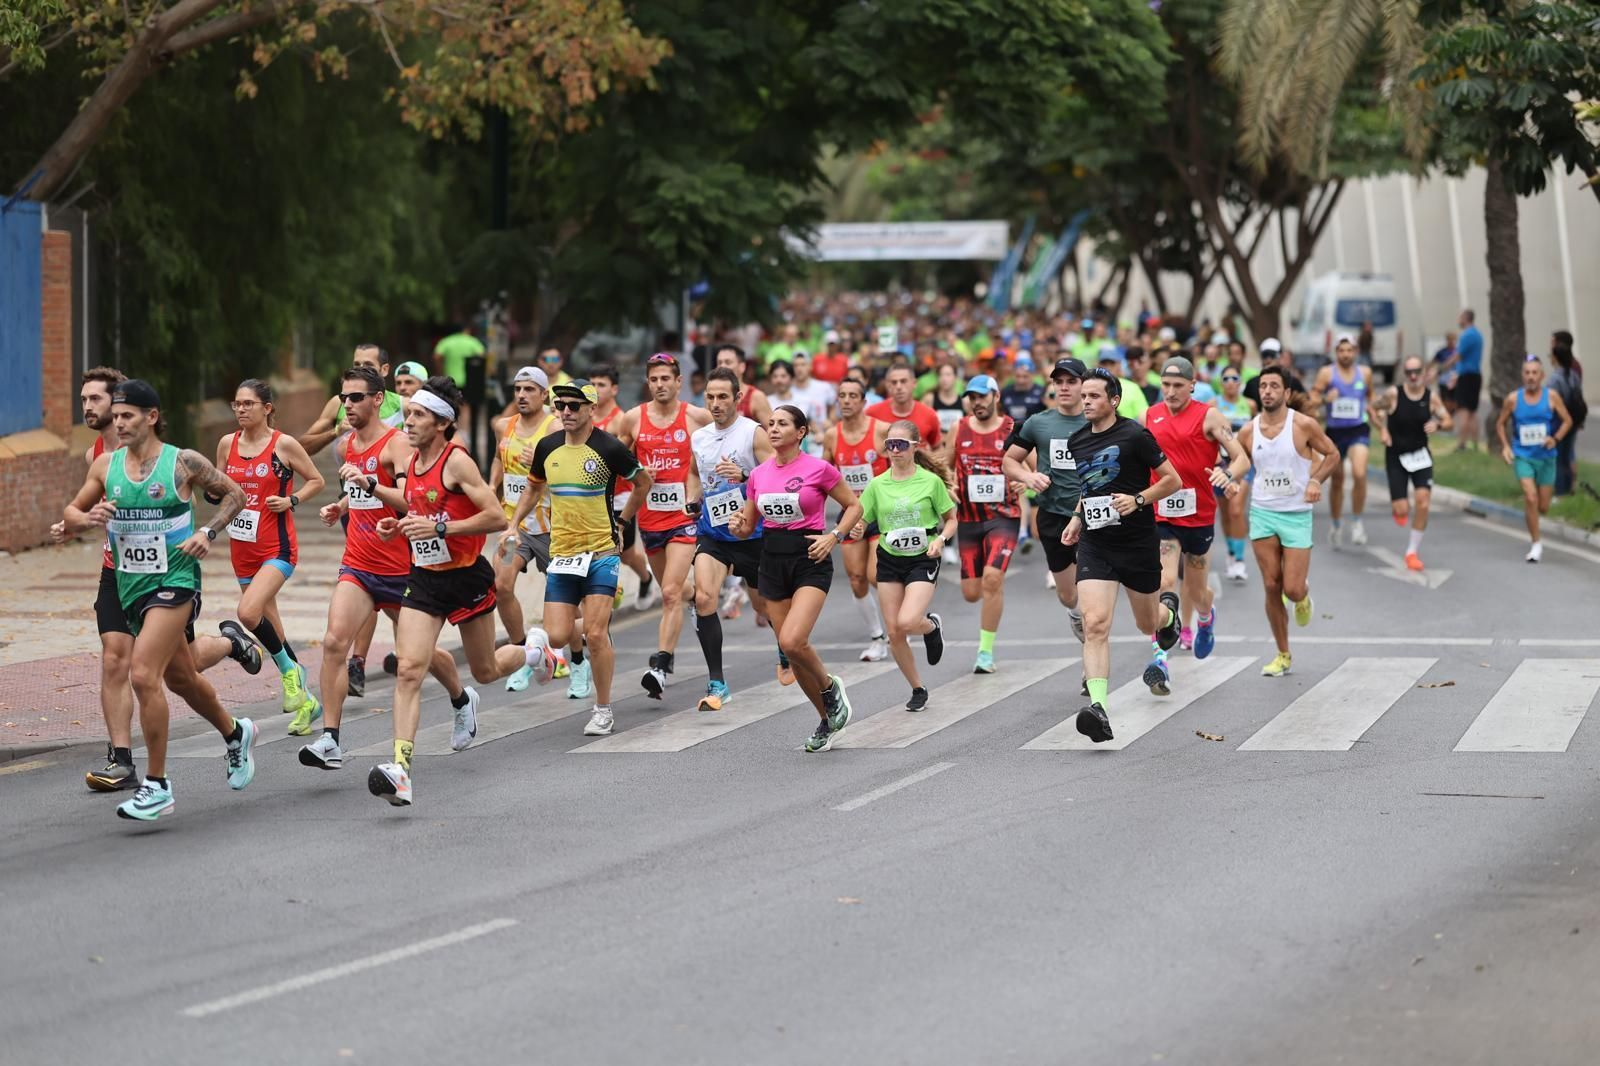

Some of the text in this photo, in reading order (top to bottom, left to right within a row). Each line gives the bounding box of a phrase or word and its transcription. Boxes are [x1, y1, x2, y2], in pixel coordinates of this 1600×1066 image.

[1055, 450, 1073, 460] 30
[845, 473, 868, 483] 486
[1265, 477, 1290, 487] 1175
[977, 484, 994, 494] 58
[650, 492, 678, 503] 804
[712, 500, 739, 517] 278
[1166, 499, 1185, 509] 90
[115, 508, 163, 519] ATLETISMO
[763, 504, 794, 516] 538
[1087, 507, 1111, 520] 931
[111, 520, 173, 533] RREMOLINOS
[416, 539, 440, 554] 624
[891, 536, 921, 548] 478
[124, 548, 158, 562] 403
[555, 556, 583, 567] 691
